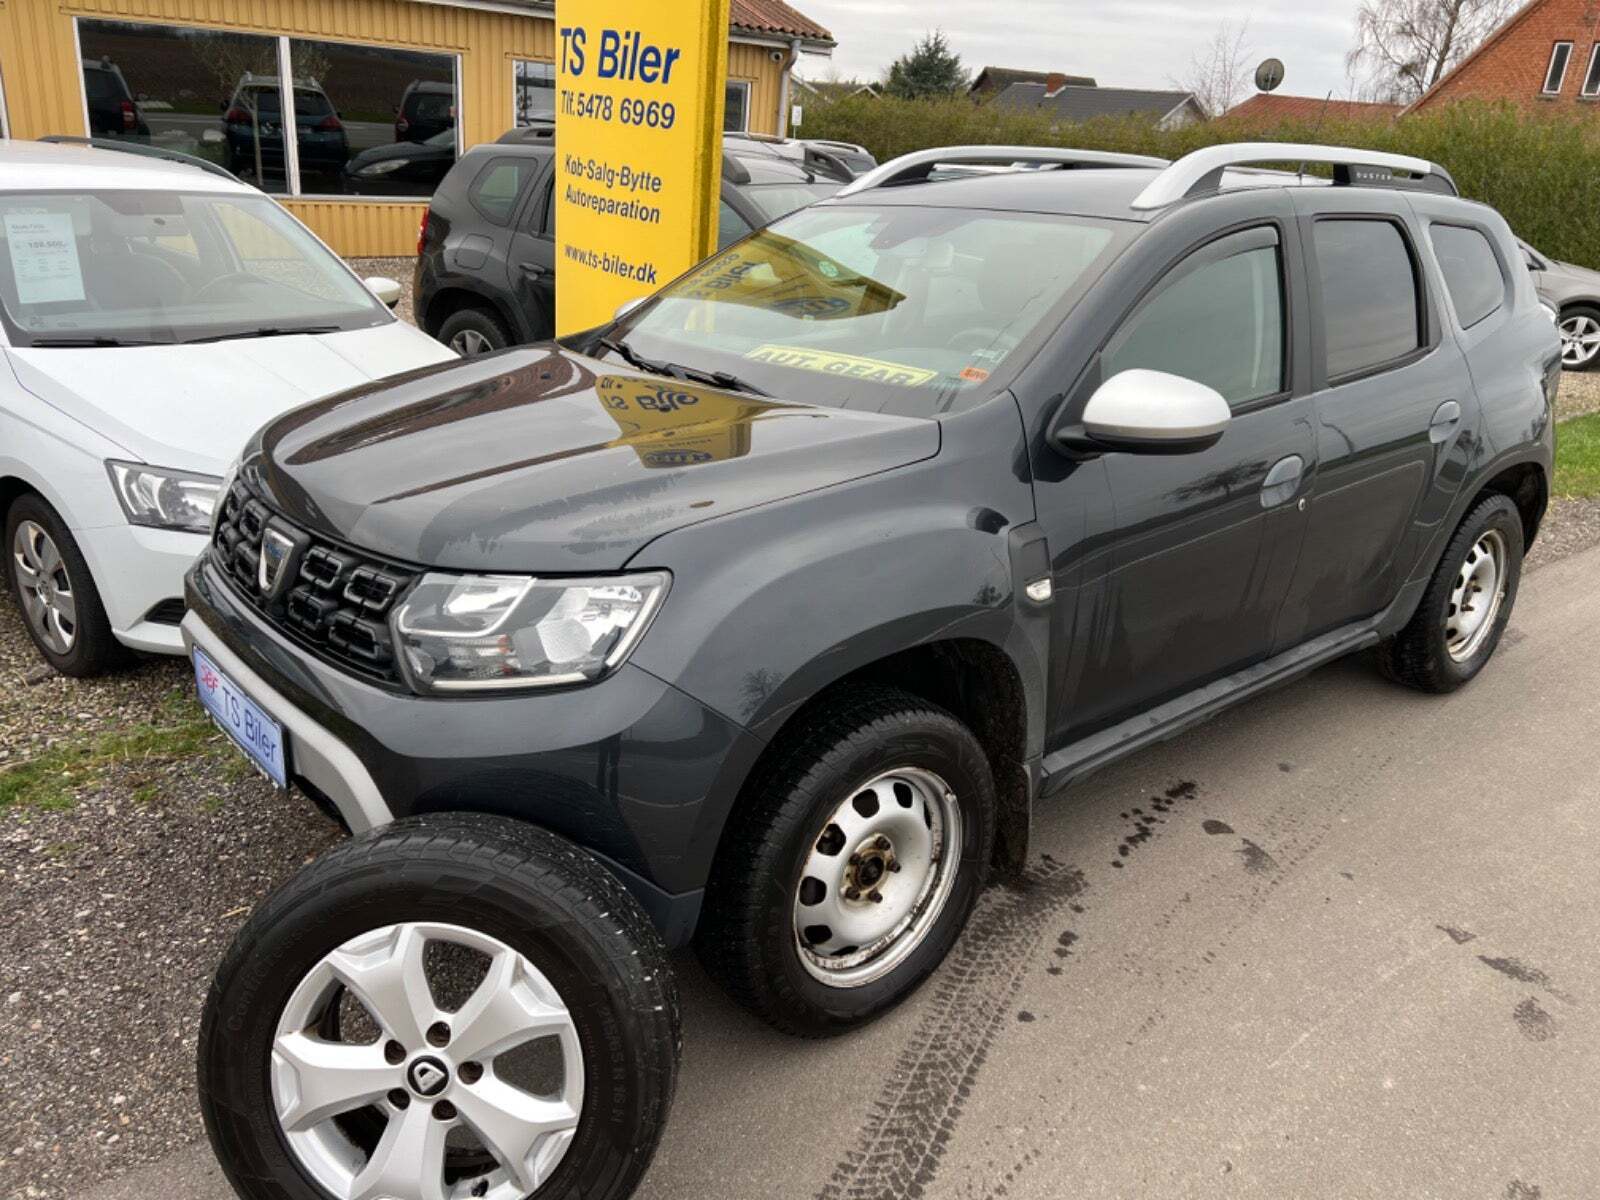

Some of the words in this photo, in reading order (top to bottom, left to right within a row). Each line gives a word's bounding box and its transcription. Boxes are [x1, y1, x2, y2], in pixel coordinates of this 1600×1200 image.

[561, 27, 586, 76] TS
[598, 30, 679, 84] Biler
[620, 98, 675, 129] 6969
[565, 184, 660, 224] Autoreparation
[564, 245, 657, 285] www.ts-biler.dk
[822, 361, 915, 386] GEAR
[223, 686, 240, 729] TS
[244, 709, 276, 762] Biler
